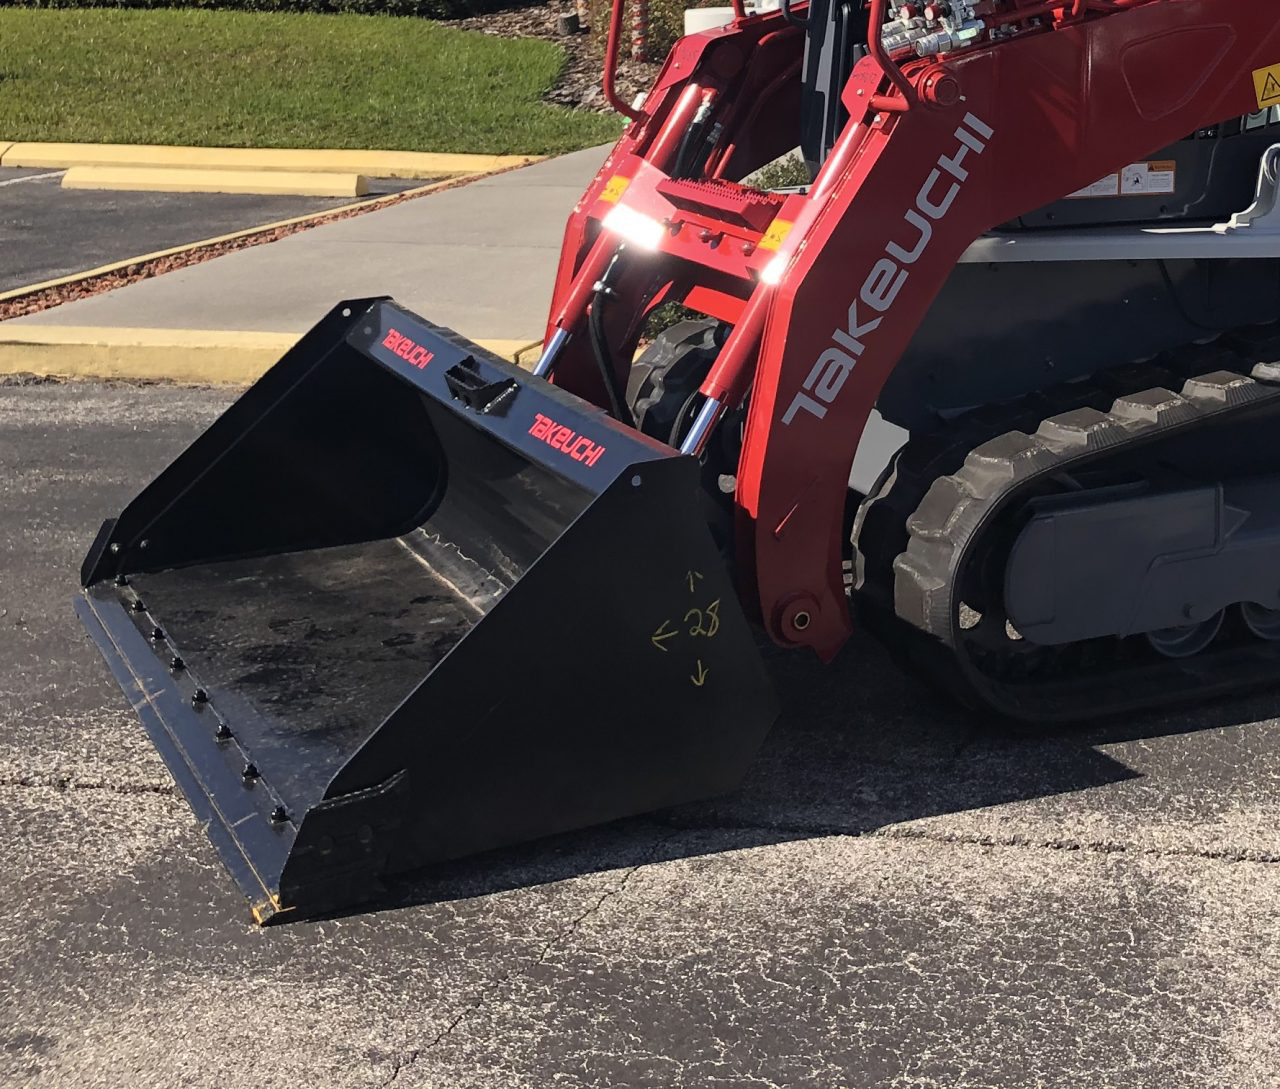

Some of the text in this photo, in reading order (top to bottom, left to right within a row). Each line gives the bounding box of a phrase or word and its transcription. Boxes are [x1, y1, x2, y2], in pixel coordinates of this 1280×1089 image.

[781, 112, 994, 425] TAKEUCHI
[381, 328, 435, 369] TAKEUCHI
[528, 413, 606, 467] TAKEUCHI
[684, 598, 721, 637] 28
